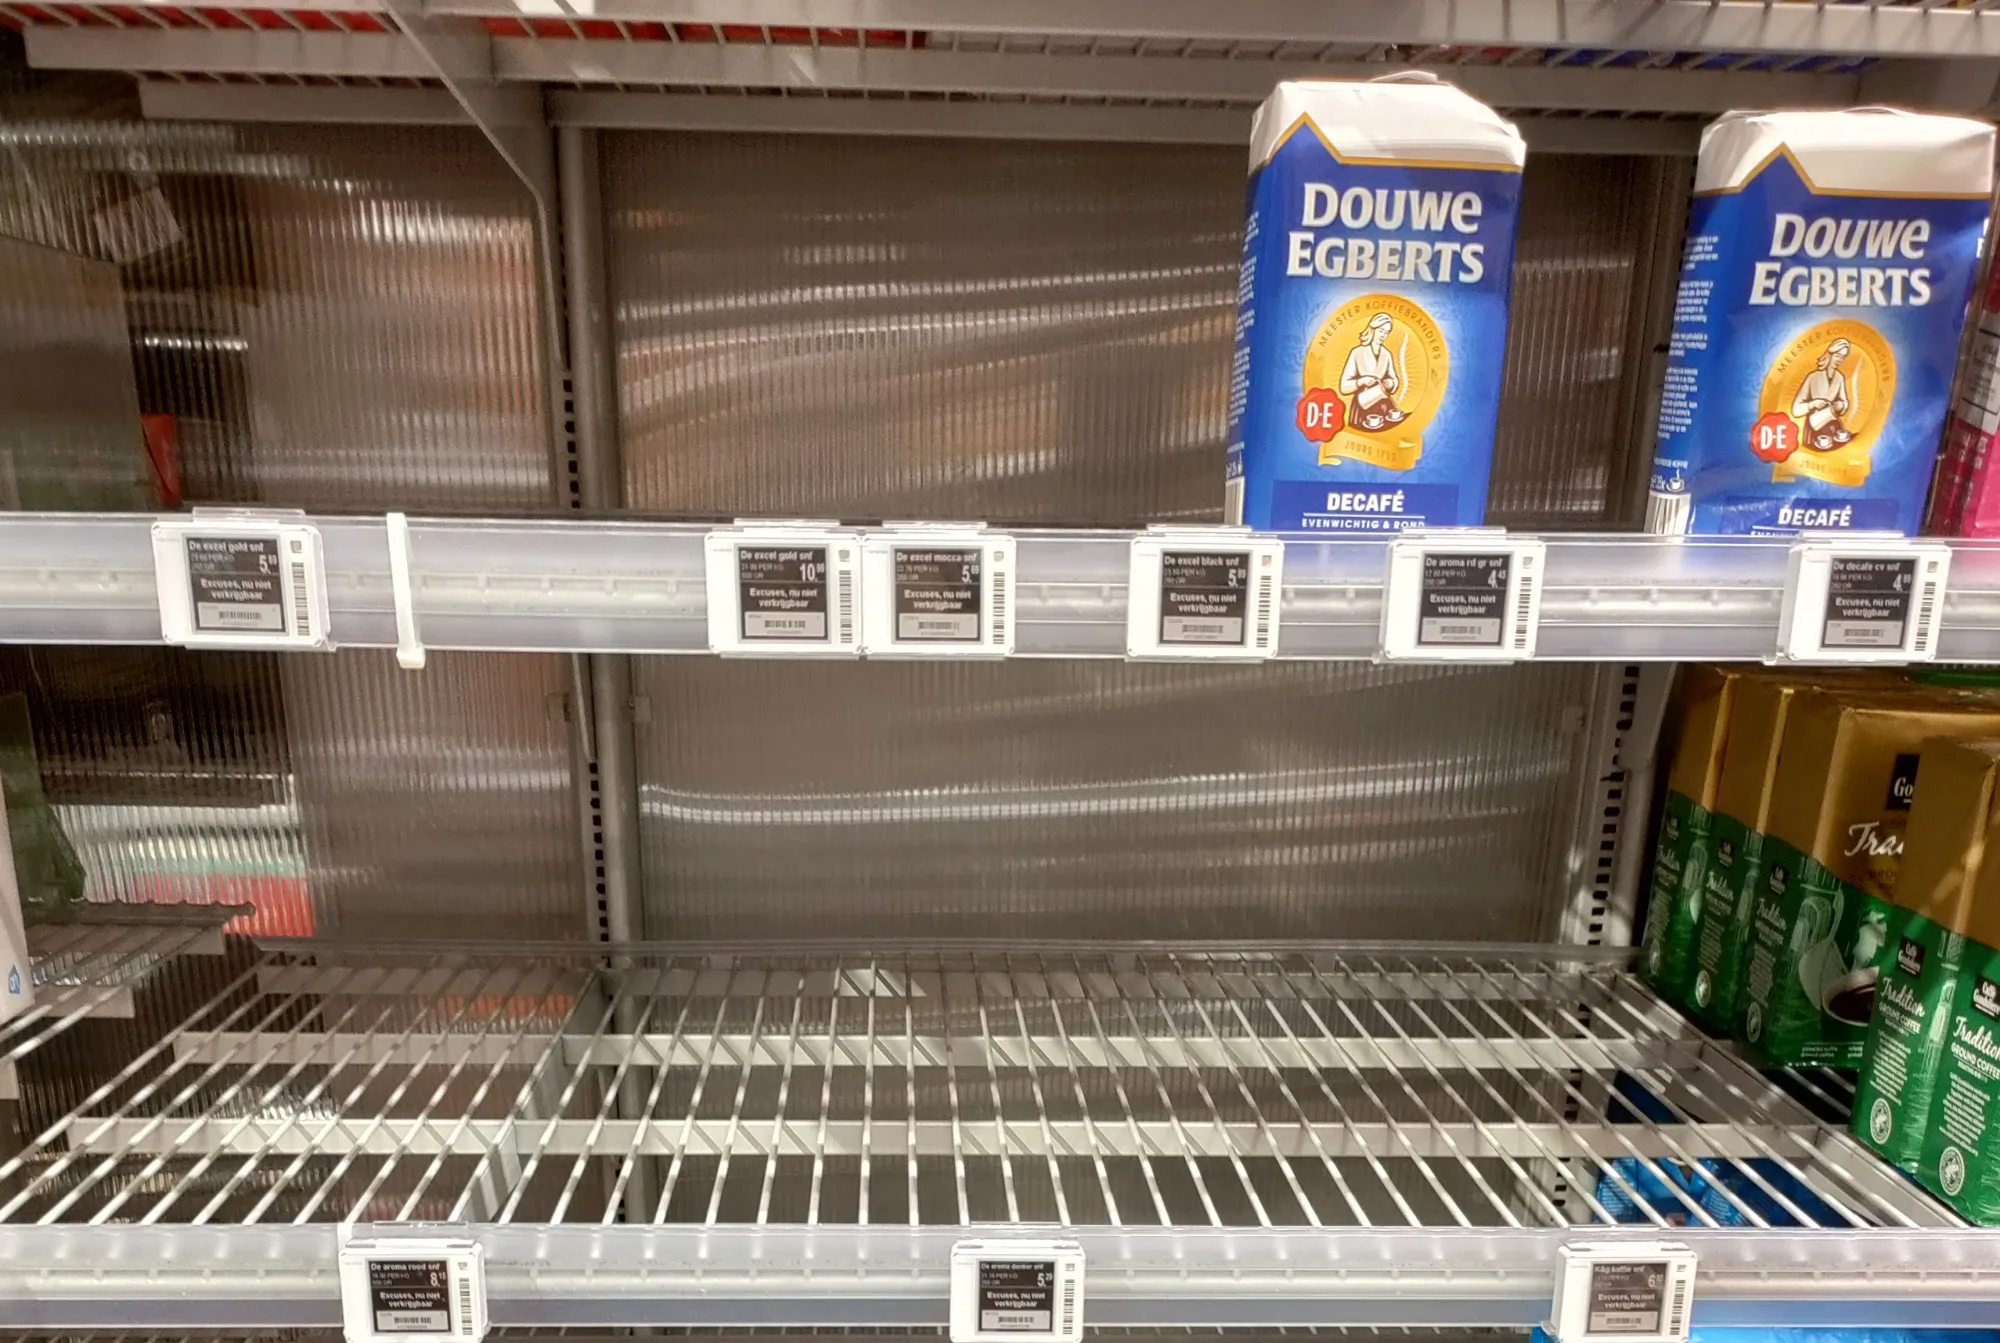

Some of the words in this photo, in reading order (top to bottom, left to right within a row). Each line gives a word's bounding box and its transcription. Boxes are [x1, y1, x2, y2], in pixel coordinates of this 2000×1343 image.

[1287, 231, 1484, 283] EGBERTS
[1748, 261, 1931, 307] EGBERTS
[1319, 304, 1361, 347] MEESTER
[1366, 300, 1442, 361] KOFFIEBRANDERS
[1777, 332, 1822, 374] MEESTER
[1326, 488, 1405, 513] DECAFÉ
[1777, 504, 1853, 527] DECAFÉ
[1301, 517, 1380, 530] EVENWICHTIG
[1382, 519, 1391, 530] &
[740, 551, 752, 560] De
[754, 551, 777, 560] excel
[778, 551, 797, 562] gold
[896, 552, 909, 562] De
[909, 553, 933, 562] excel
[933, 553, 962, 563] mocca
[1164, 556, 1176, 566] De
[1178, 556, 1200, 566] excel
[1201, 556, 1223, 567] black
[1425, 557, 1437, 567] De
[1439, 558, 1465, 567] aroma
[1466, 558, 1477, 568] rd
[1478, 559, 1487, 569] gr
[1833, 561, 1845, 571] De
[749, 588, 788, 599] Excuses,
[788, 588, 800, 598] nu
[801, 588, 818, 598] niet
[904, 589, 942, 600] Excuses,
[943, 589, 955, 600] nu
[955, 589, 972, 600] niet
[1430, 593, 1467, 605] Excuses,
[1468, 594, 1480, 605] nu
[1480, 594, 1497, 604] niet
[1835, 597, 1872, 608] Excuses,
[1872, 598, 1884, 608] nu
[1884, 598, 1901, 608] niet
[1881, 976, 1926, 1018] Tradition
[1900, 1014, 1921, 1034] COFFEE
[1950, 1041, 1977, 1065] GROUND
[370, 1263, 382, 1271] De
[383, 1263, 407, 1271] aroma
[408, 1263, 427, 1271] rood
